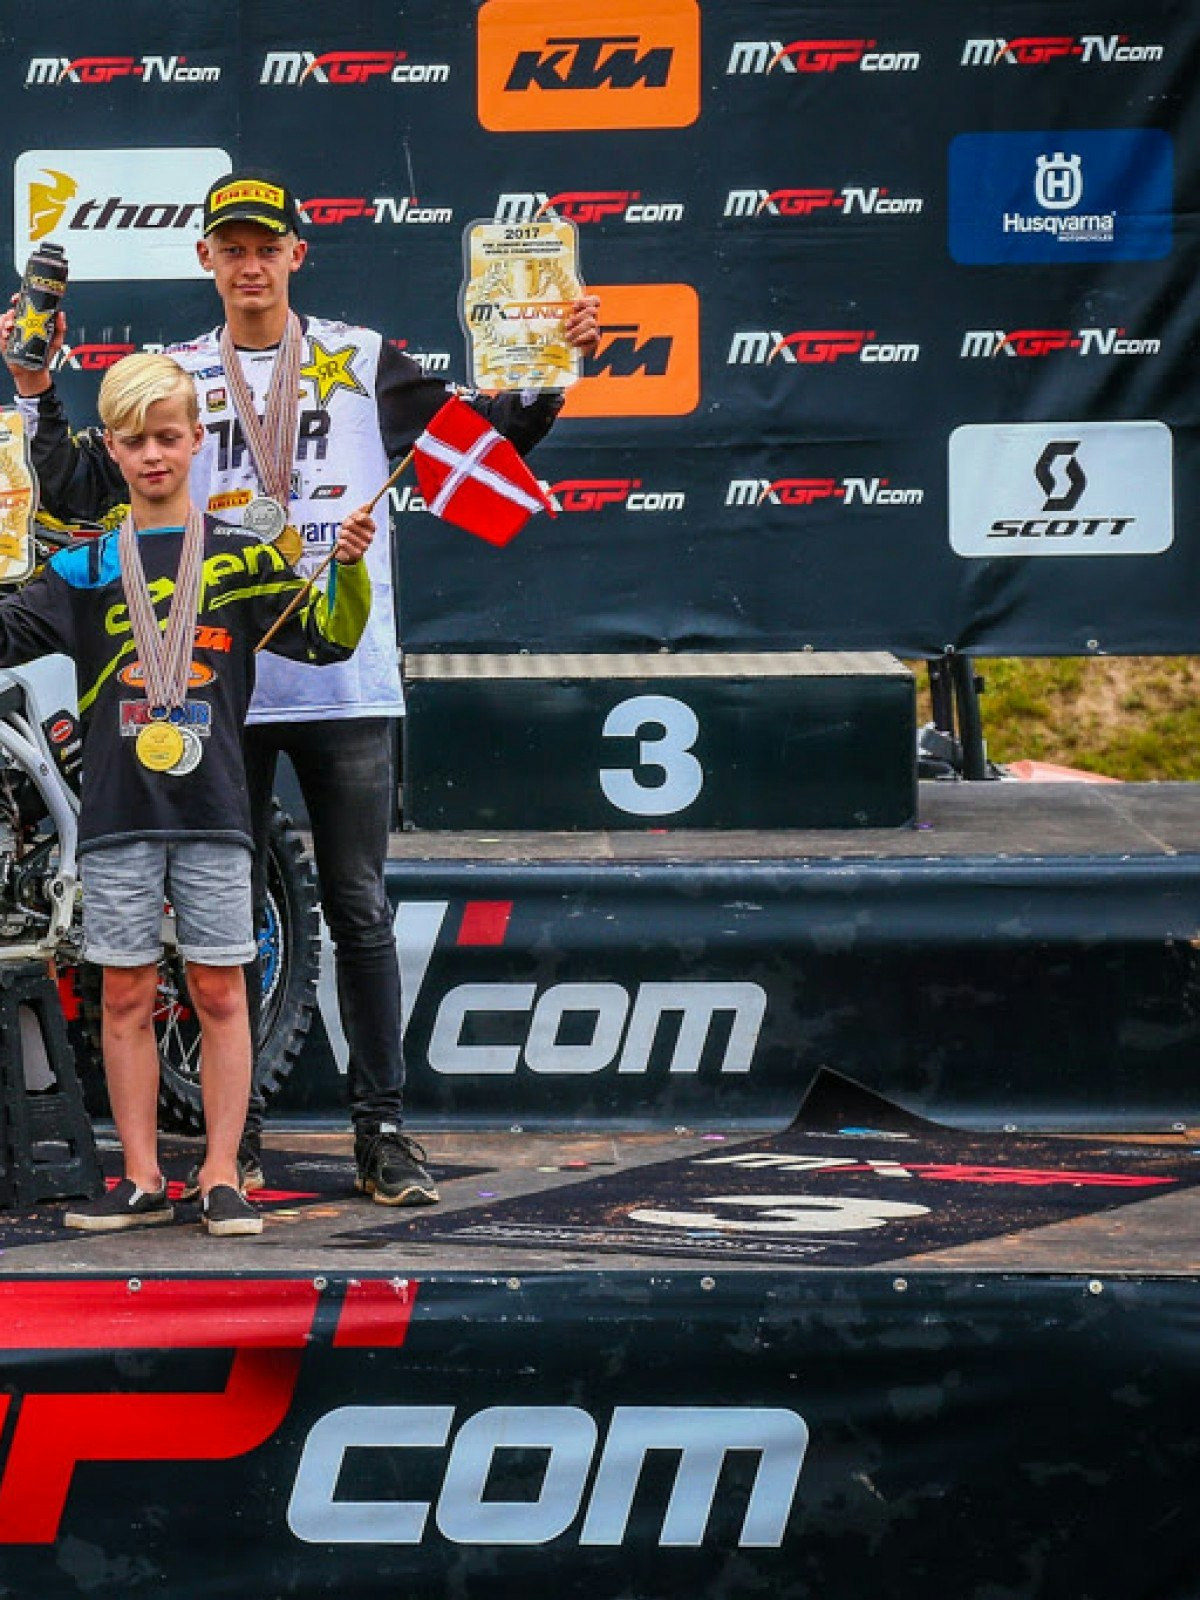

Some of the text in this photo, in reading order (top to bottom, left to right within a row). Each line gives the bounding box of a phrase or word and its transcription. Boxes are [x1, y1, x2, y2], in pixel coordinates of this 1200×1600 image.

[504, 37, 674, 91] KTM
[504, 227, 540, 240] 2017
[1003, 212, 1115, 238] Husqvarna
[987, 517, 1136, 539] SCOTT
[600, 695, 704, 816] 3
[628, 1194, 932, 1232] 3
